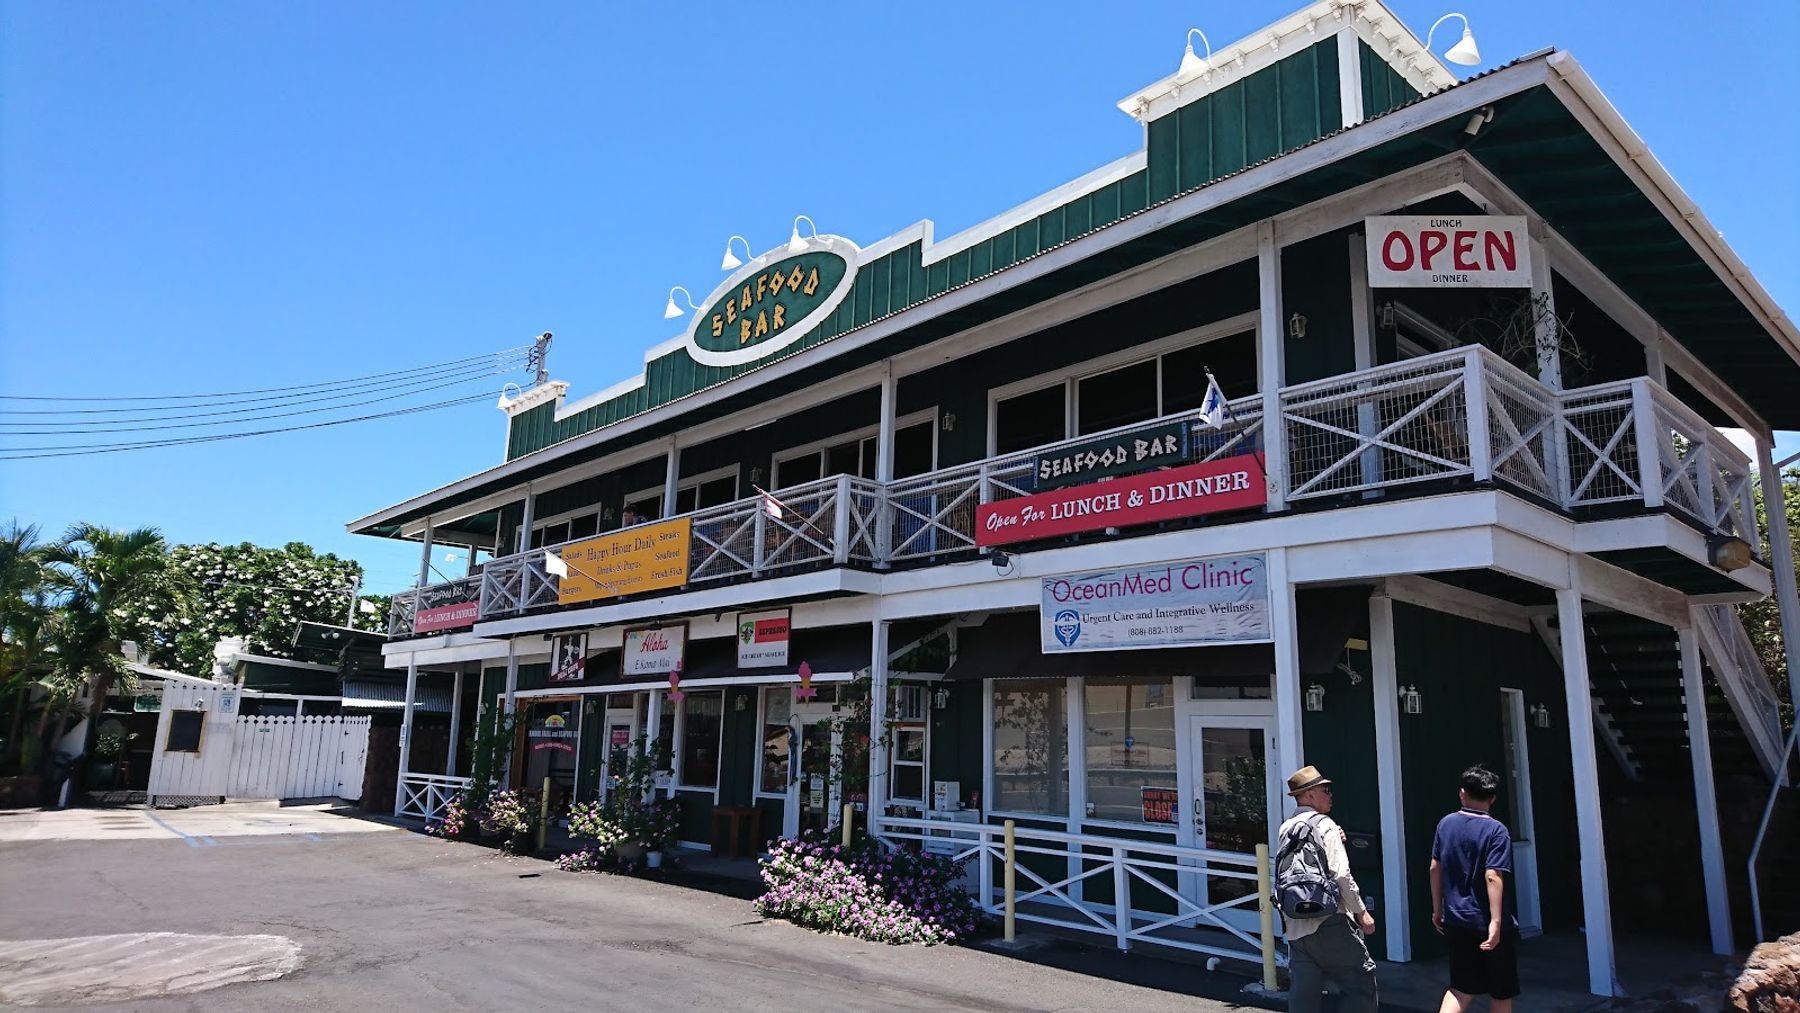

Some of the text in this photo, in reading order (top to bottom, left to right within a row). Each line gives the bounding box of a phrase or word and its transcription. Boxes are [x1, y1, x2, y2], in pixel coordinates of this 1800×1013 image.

[1430, 219, 1462, 228] LUNCH
[1382, 230, 1517, 271] OPEN
[1432, 274, 1469, 283] DINNER
[711, 263, 819, 337] SEAFOOD
[740, 303, 785, 344] BAR
[1039, 434, 1178, 480] SEAFOOD BAR
[986, 471, 1250, 531] Open For LUNCH & DINNER
[659, 531, 680, 542] Steaks
[586, 534, 656, 562] Happy Hour Daily
[655, 550, 680, 561] Seafood
[669, 567, 682, 577] Fish
[1053, 561, 1253, 601] OceanMed Clinic
[1082, 601, 1255, 624] Urgent Care and Integrative Wellness
[640, 632, 669, 652] Aloha
[1127, 627, 1146, 637] (808)
[1144, 801, 1177, 820] CLOSE
